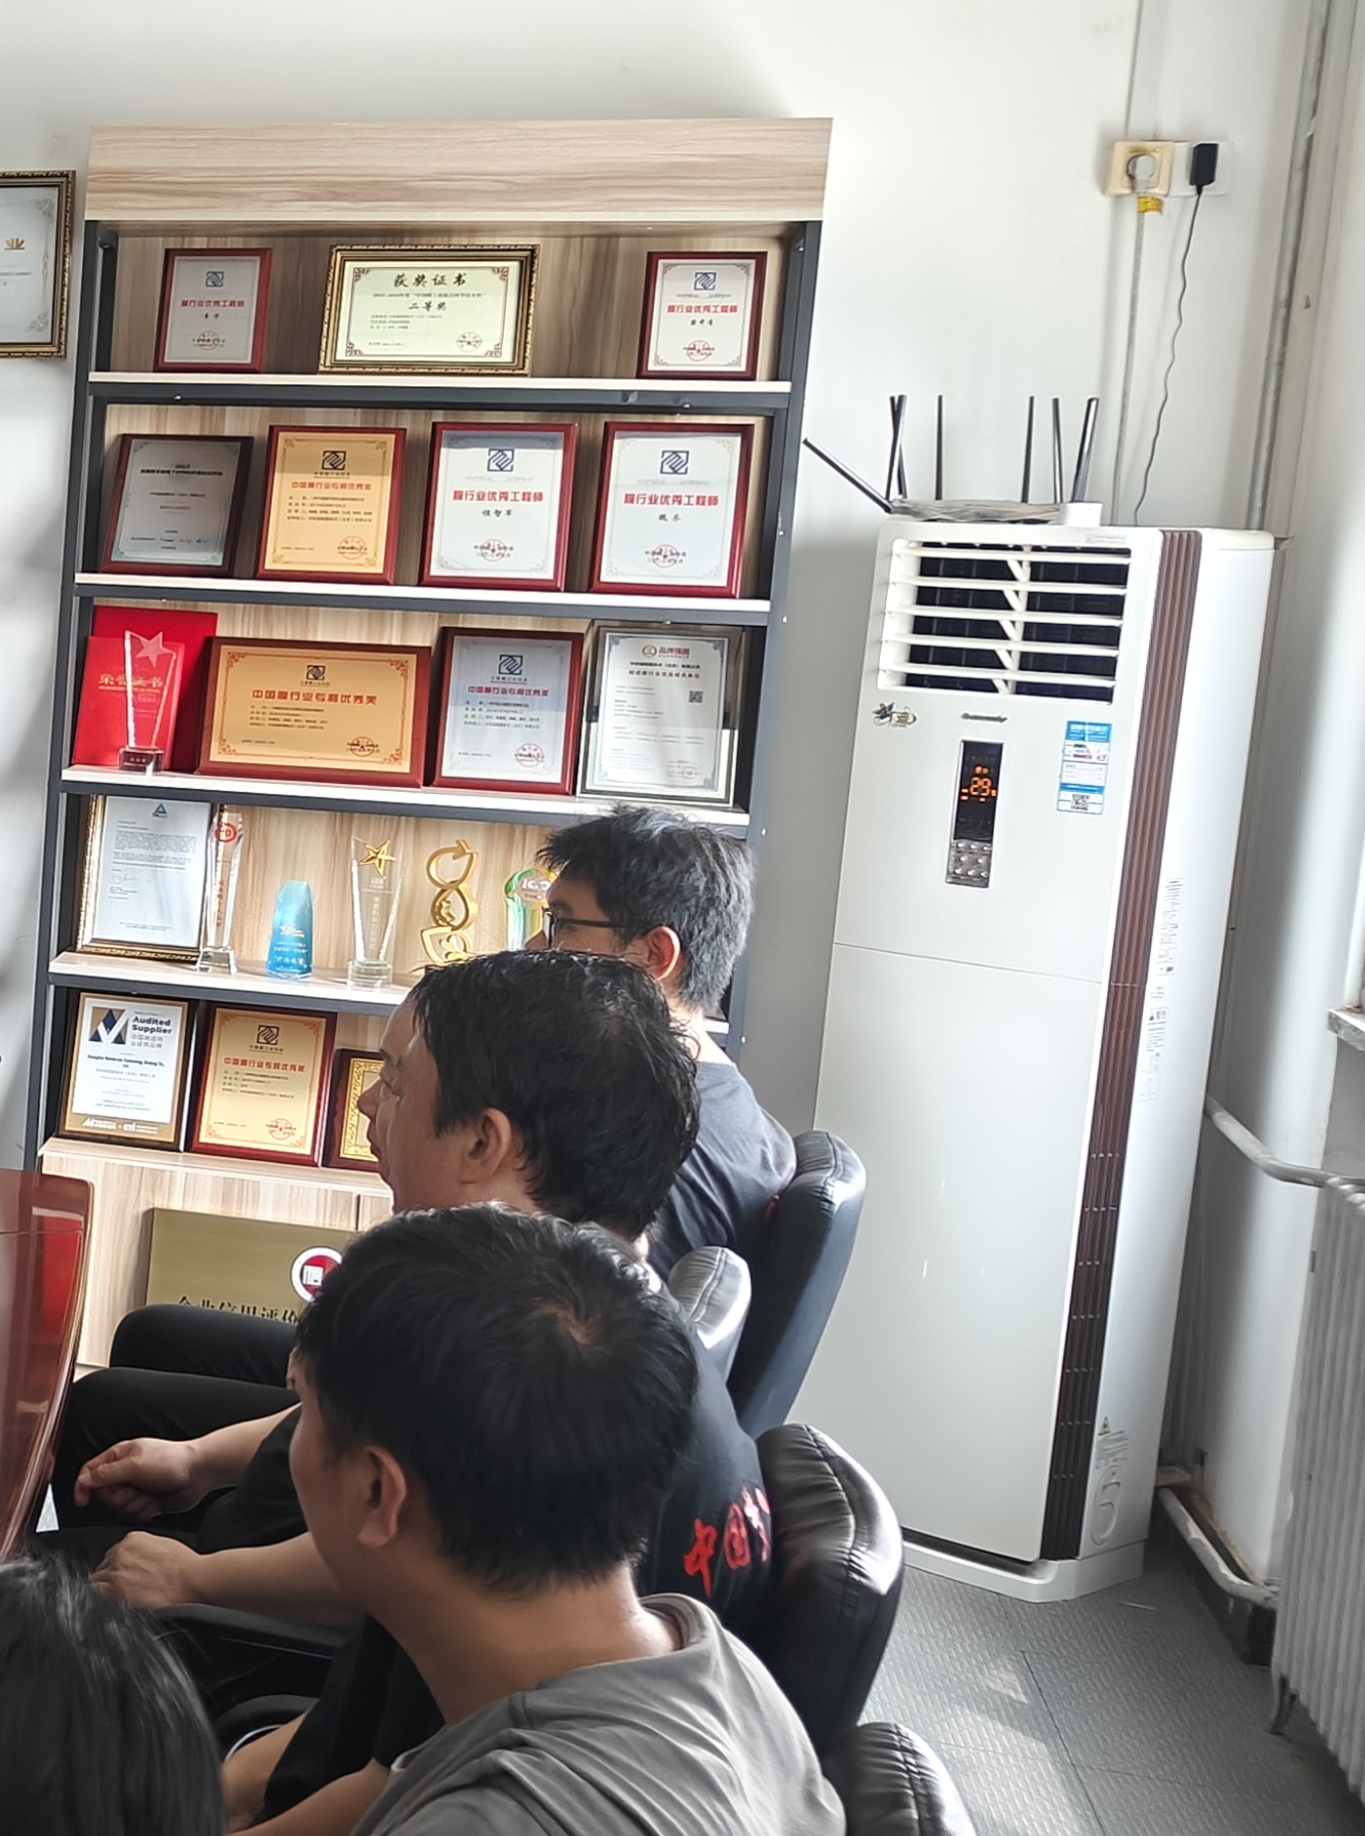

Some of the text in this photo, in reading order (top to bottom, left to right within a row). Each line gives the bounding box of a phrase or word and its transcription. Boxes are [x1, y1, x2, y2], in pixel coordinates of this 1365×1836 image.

[394, 272, 467, 288] 获奖证书
[132, 1016, 171, 1026] Audited
[131, 1024, 173, 1035] Supplier
